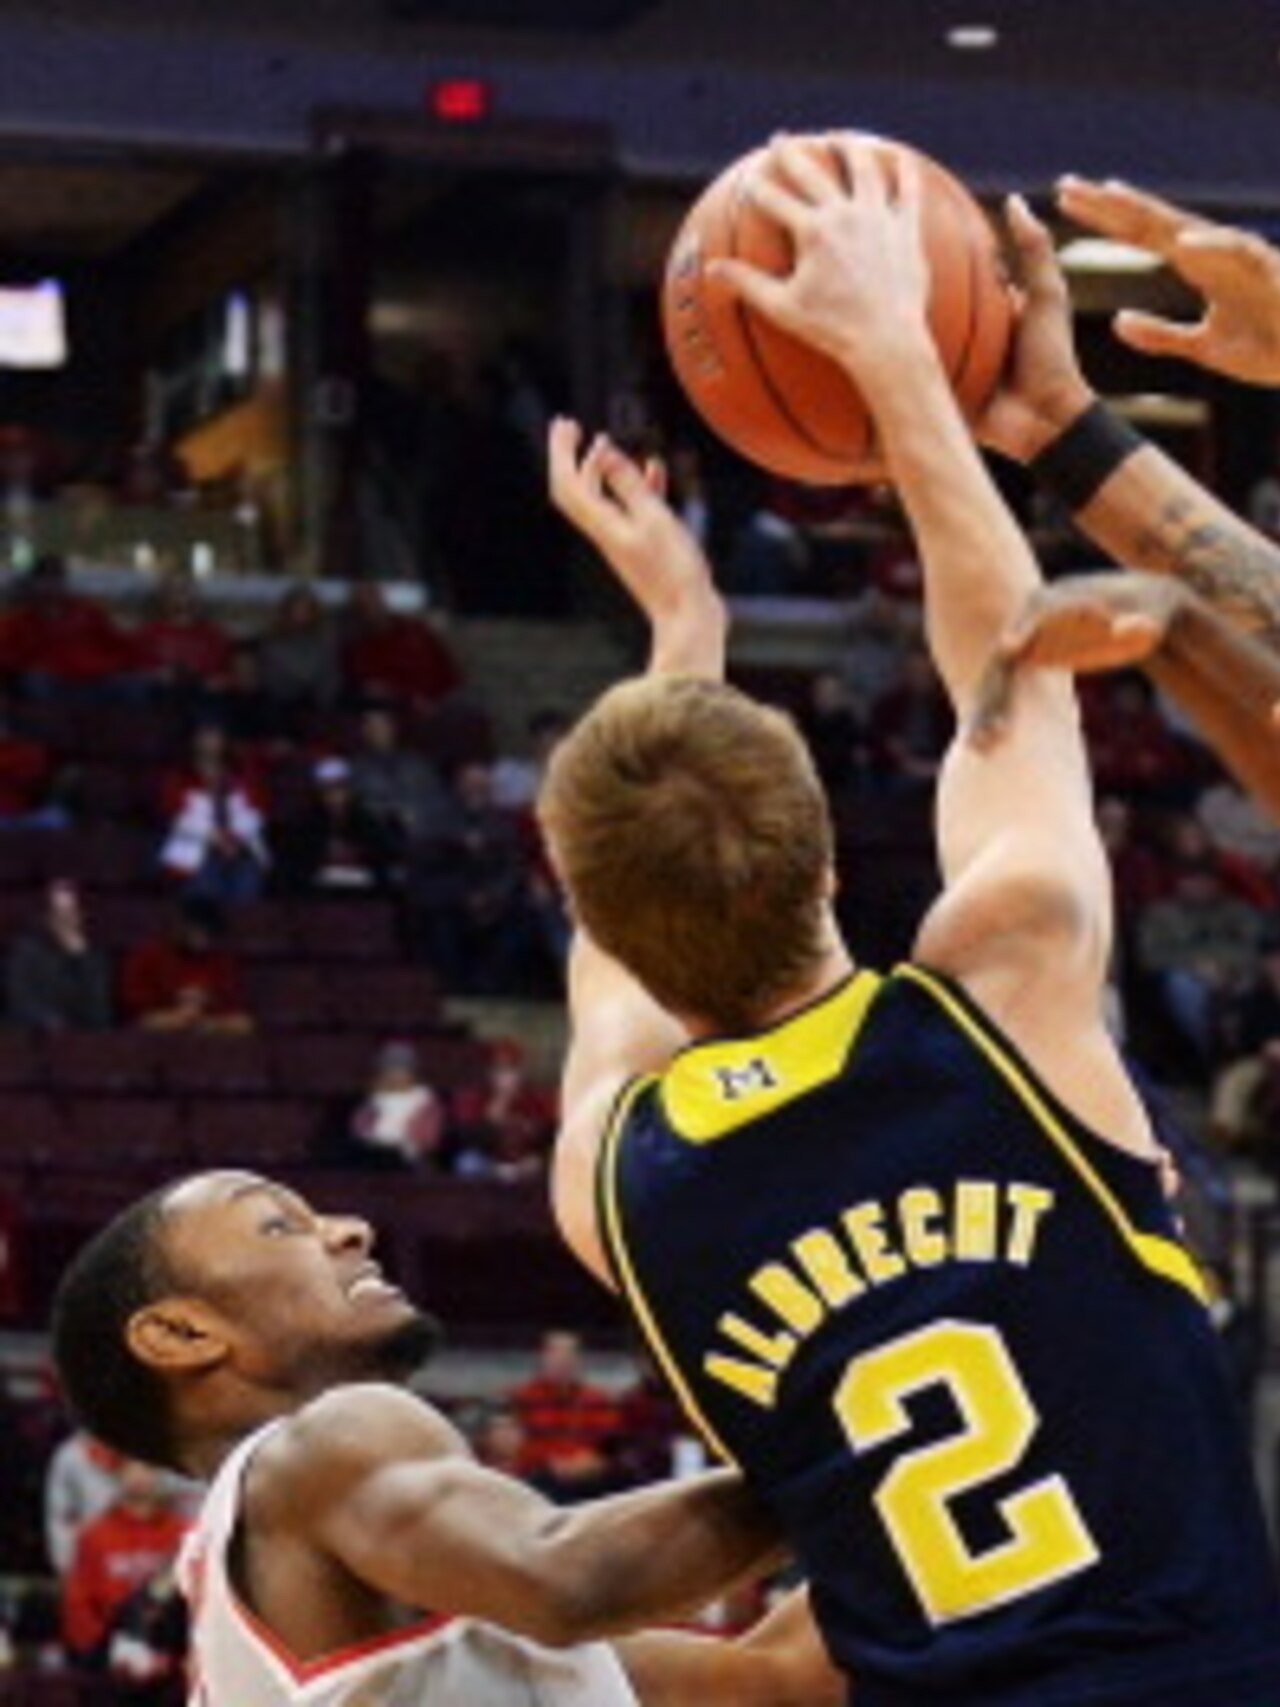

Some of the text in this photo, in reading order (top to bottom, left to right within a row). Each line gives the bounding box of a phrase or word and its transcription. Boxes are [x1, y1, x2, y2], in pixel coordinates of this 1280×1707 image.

[713, 1058, 777, 1100] M
[703, 1177, 1054, 1410] ALBRECHT
[833, 1318, 1101, 1627] 2
